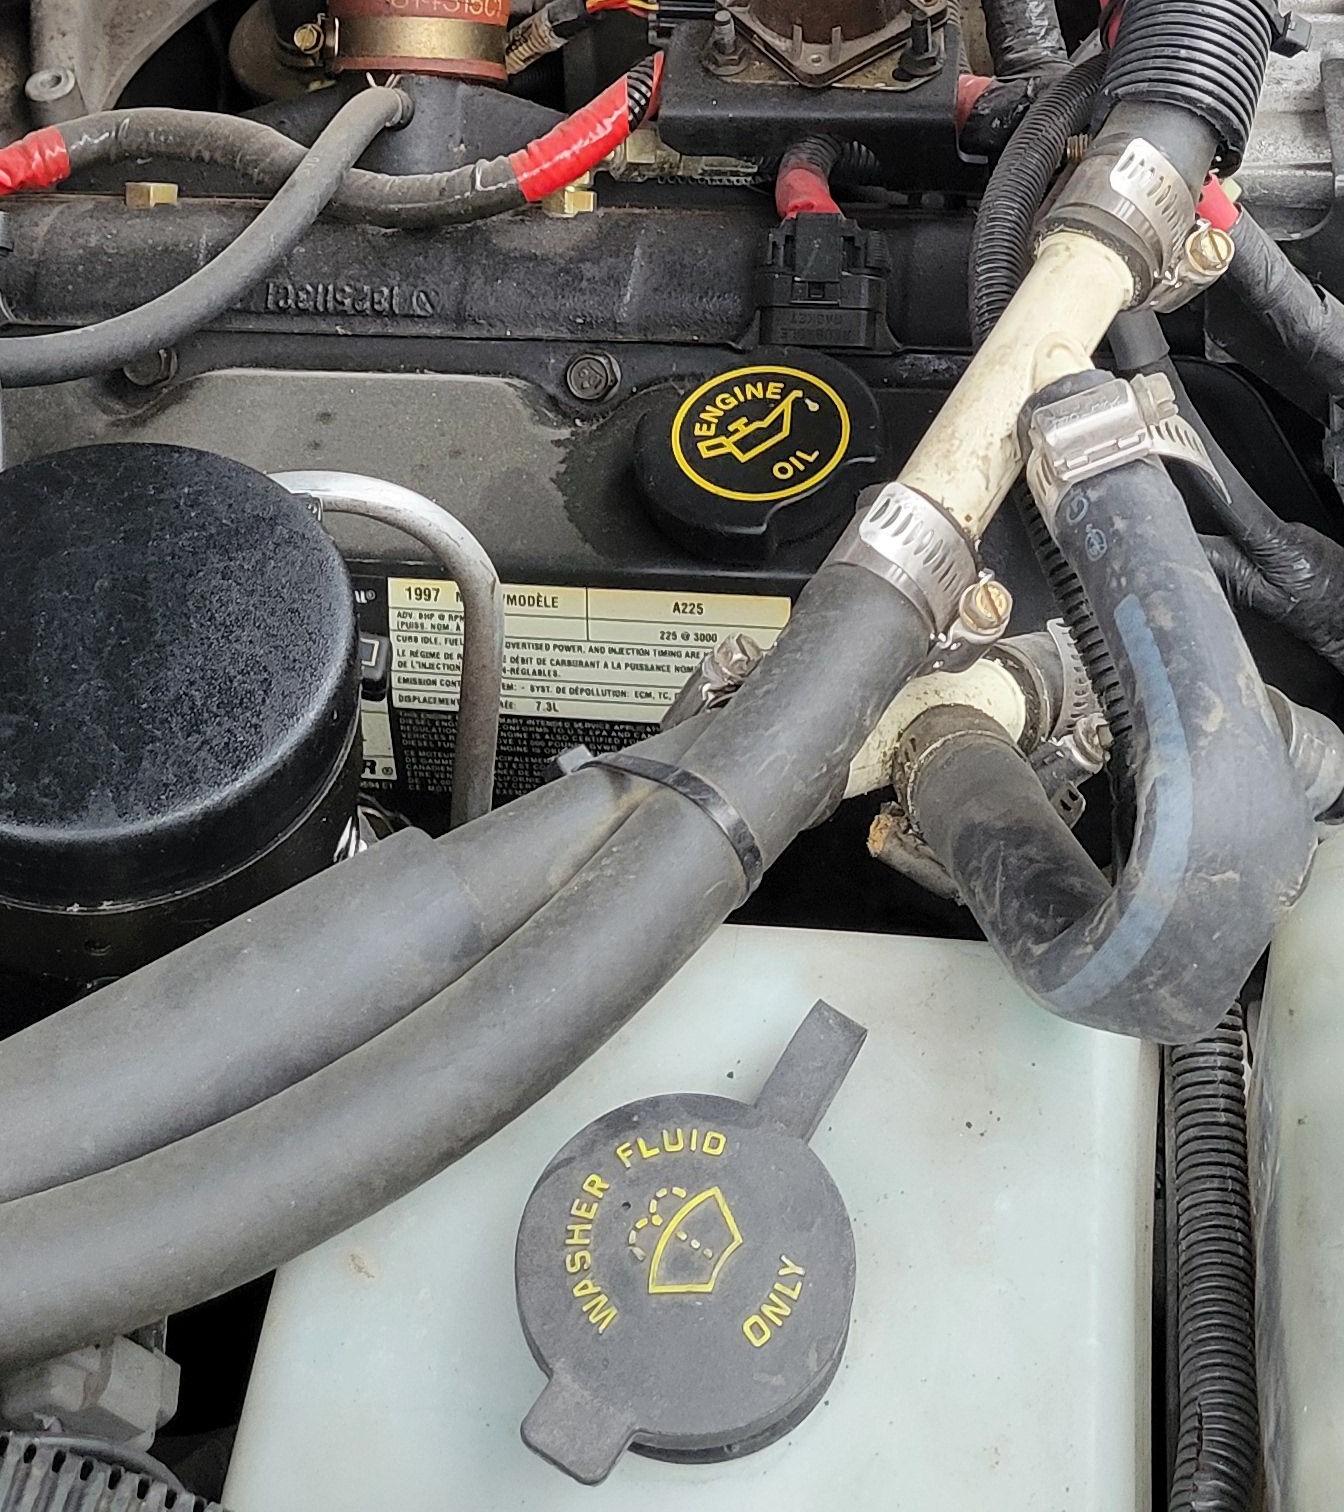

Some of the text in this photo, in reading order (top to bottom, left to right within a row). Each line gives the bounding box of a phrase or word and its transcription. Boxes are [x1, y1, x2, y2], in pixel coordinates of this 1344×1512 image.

[693, 381, 785, 437] ENGINE
[772, 450, 820, 480] OIL
[405, 586, 441, 602] 1997
[672, 601, 704, 616] A225
[659, 630, 718, 643] 225 @ 3000
[535, 700, 560, 713] 7.3L
[615, 1127, 727, 1169] FLUID
[564, 1172, 619, 1335] WASHER
[741, 1254, 807, 1348] ONLY
